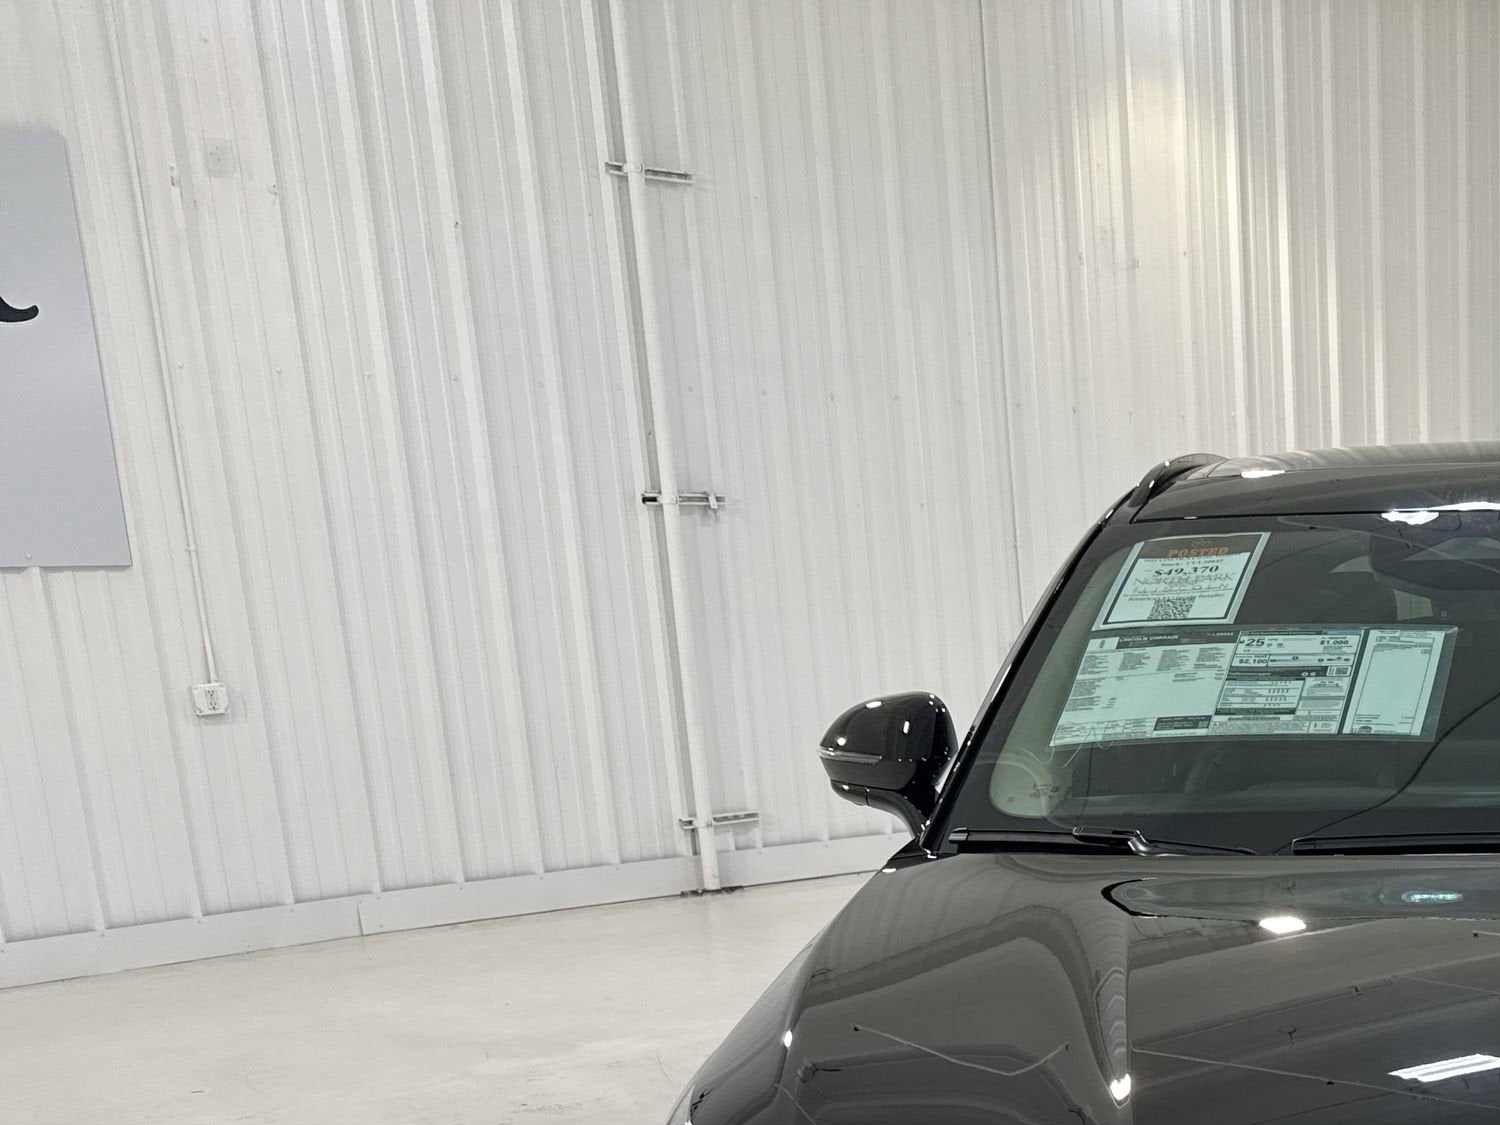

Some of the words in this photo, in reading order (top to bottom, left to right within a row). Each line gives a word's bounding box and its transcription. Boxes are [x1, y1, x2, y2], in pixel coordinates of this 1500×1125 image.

[1167, 547, 1230, 557] POSTED
[1153, 565, 1219, 577] $49,370
[1245, 638, 1265, 647] 25
